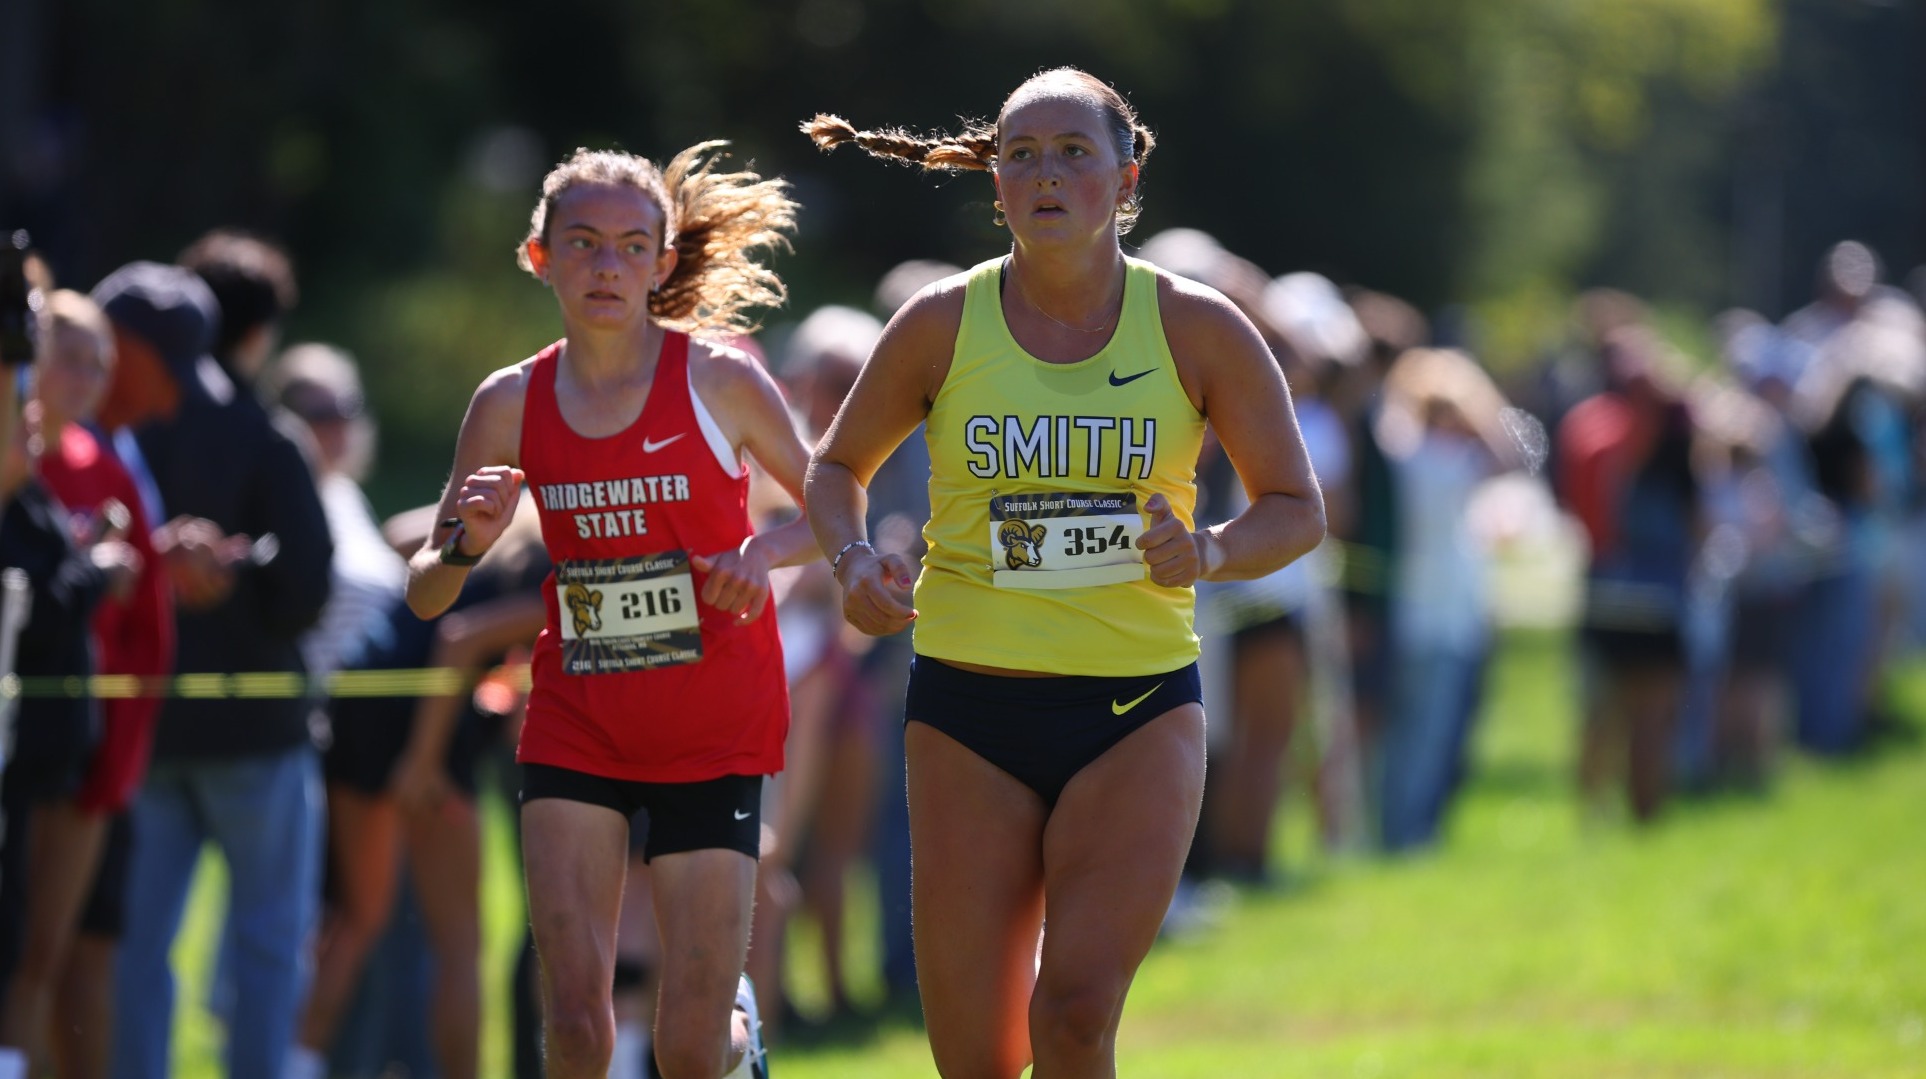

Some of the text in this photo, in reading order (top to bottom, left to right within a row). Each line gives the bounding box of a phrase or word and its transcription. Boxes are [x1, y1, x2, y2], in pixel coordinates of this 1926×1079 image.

[965, 415, 1156, 480] SMITH
[538, 474, 690, 511] BRIDGEWATER
[1004, 498, 1122, 512] SUFFOLK SHORT COURSE CLASSIC
[573, 509, 648, 540] STATE
[1063, 524, 1132, 556] 354
[620, 586, 682, 620] 216
[572, 660, 592, 671] 216
